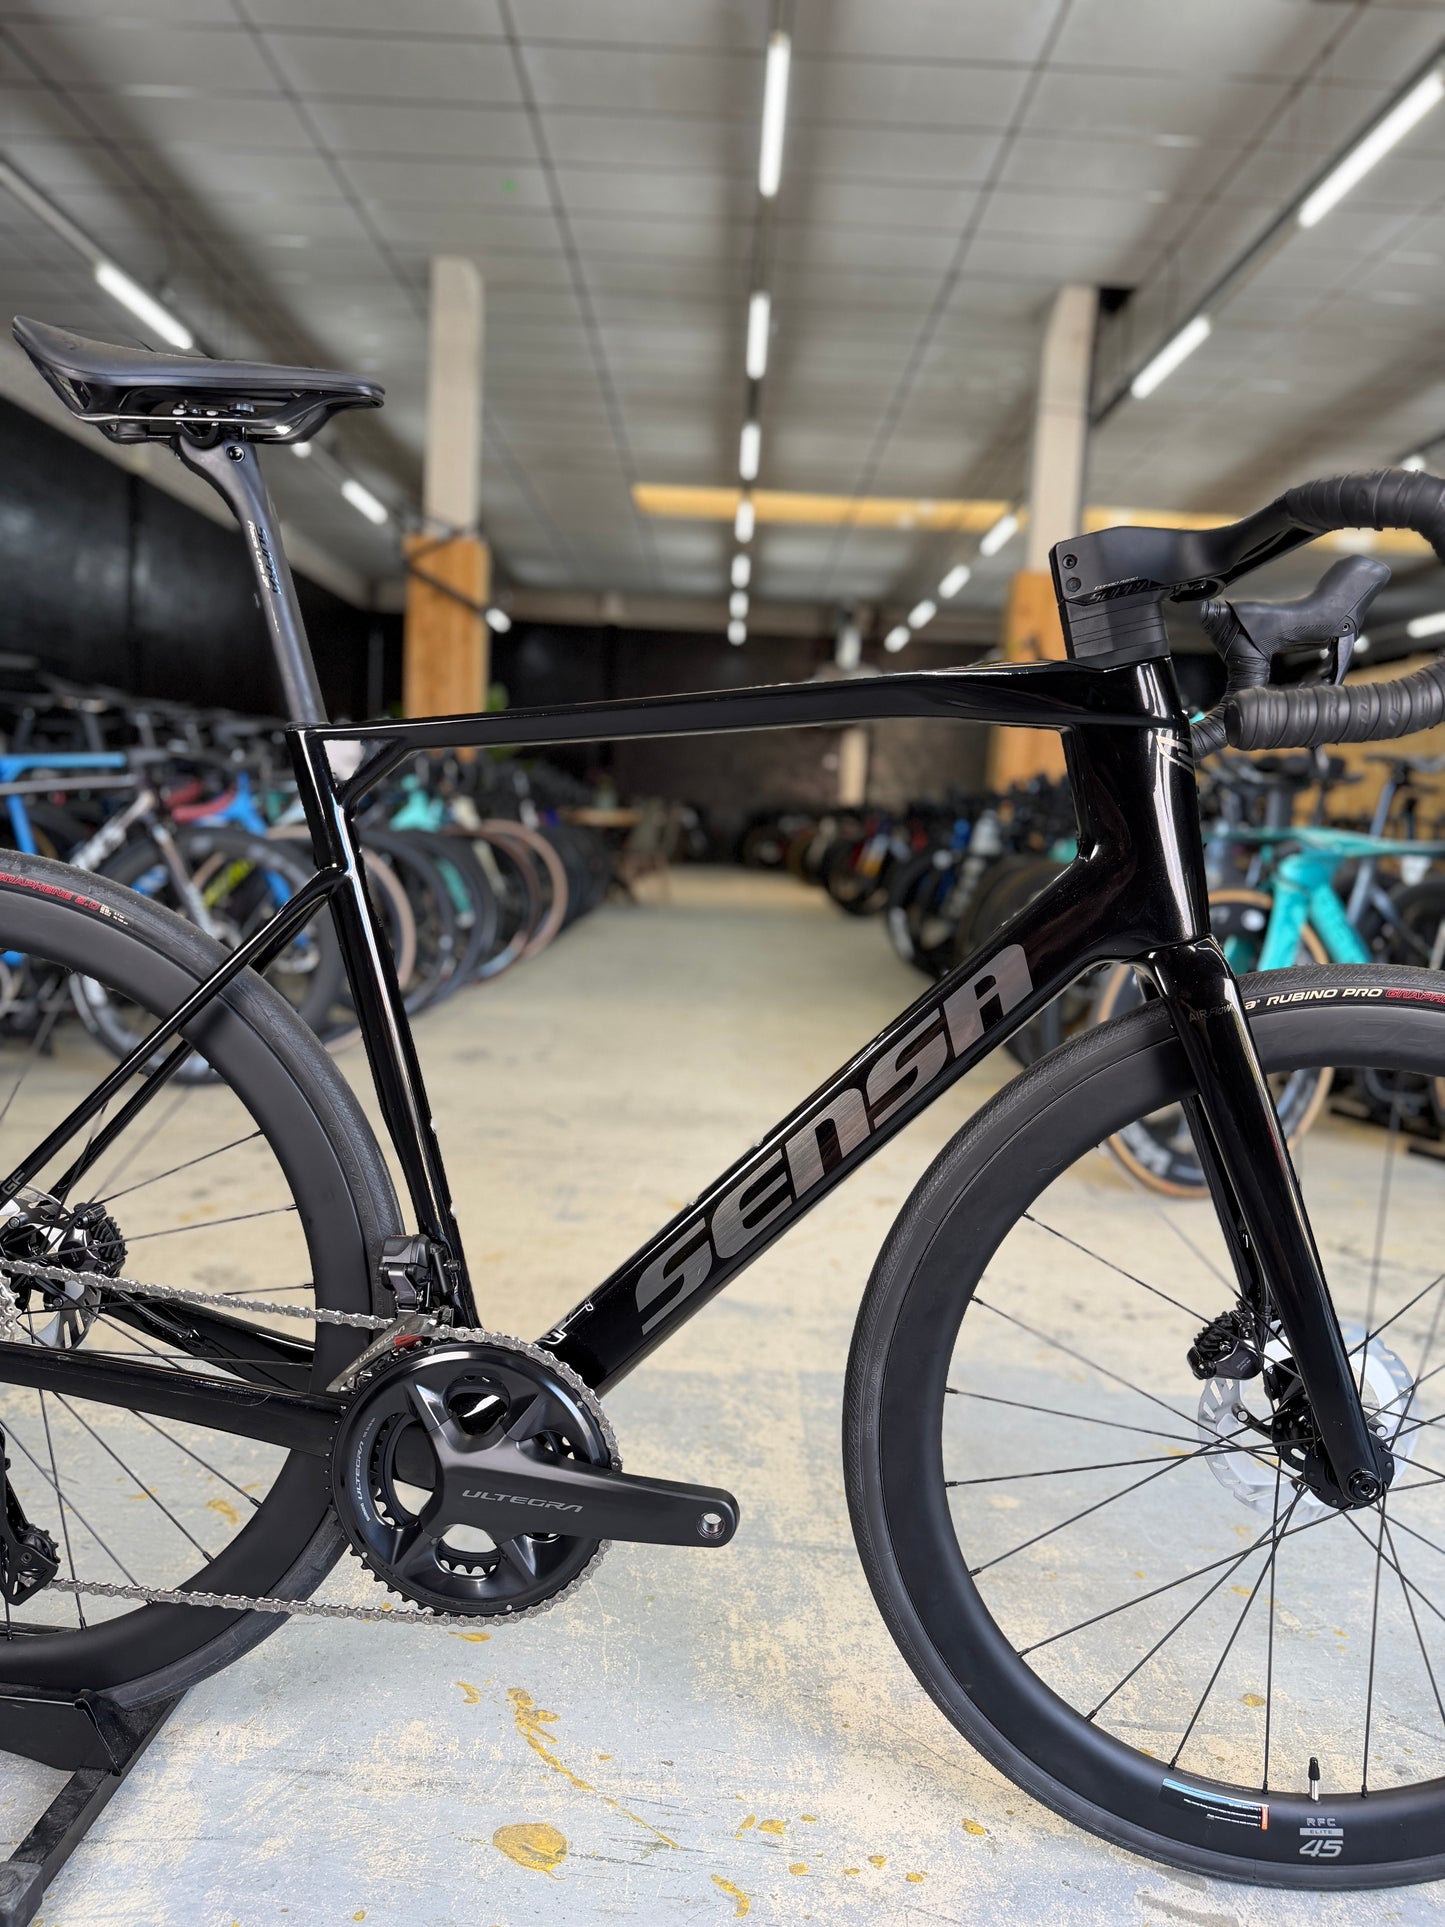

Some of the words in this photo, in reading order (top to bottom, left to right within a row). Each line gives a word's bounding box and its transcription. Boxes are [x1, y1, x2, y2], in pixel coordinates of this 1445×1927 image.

[1266, 988, 1337, 1006] RUBINO
[1341, 988, 1383, 998] PRO
[1188, 1009, 1209, 1023] AIR
[359, 1325, 405, 1363] ULTEGRA
[355, 1440, 364, 1500] ULTEGRA
[461, 1489, 584, 1513] ULTEGRA
[1306, 1817, 1336, 1827] RFC
[1299, 1839, 1345, 1858] 45
